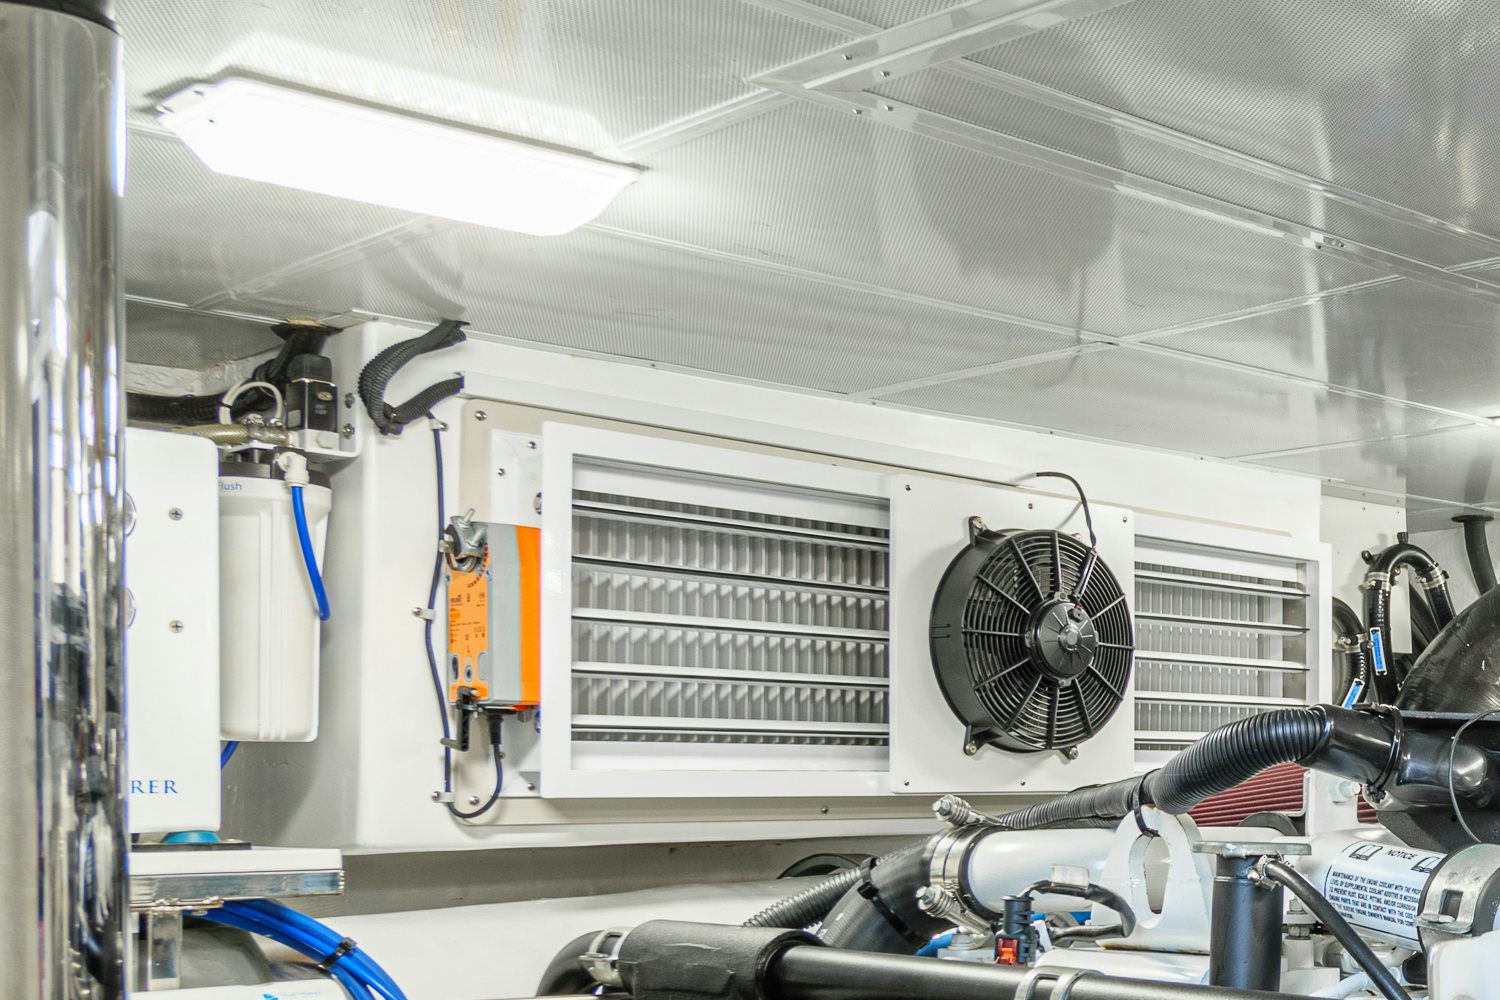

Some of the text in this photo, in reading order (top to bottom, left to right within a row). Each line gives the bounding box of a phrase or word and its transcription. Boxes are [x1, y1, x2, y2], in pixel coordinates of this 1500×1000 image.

[130, 780, 178, 794] RER
[1385, 849, 1418, 860] NOTICE
[1332, 871, 1354, 880] MAINTENANCE
[1366, 878, 1379, 886] ENGINE
[1379, 881, 1394, 889] COOLANT
[1411, 887, 1421, 895] PROP
[1369, 887, 1384, 895] COOLANT
[1403, 895, 1419, 903] NECESSA
[1372, 904, 1387, 913] CONTACT
